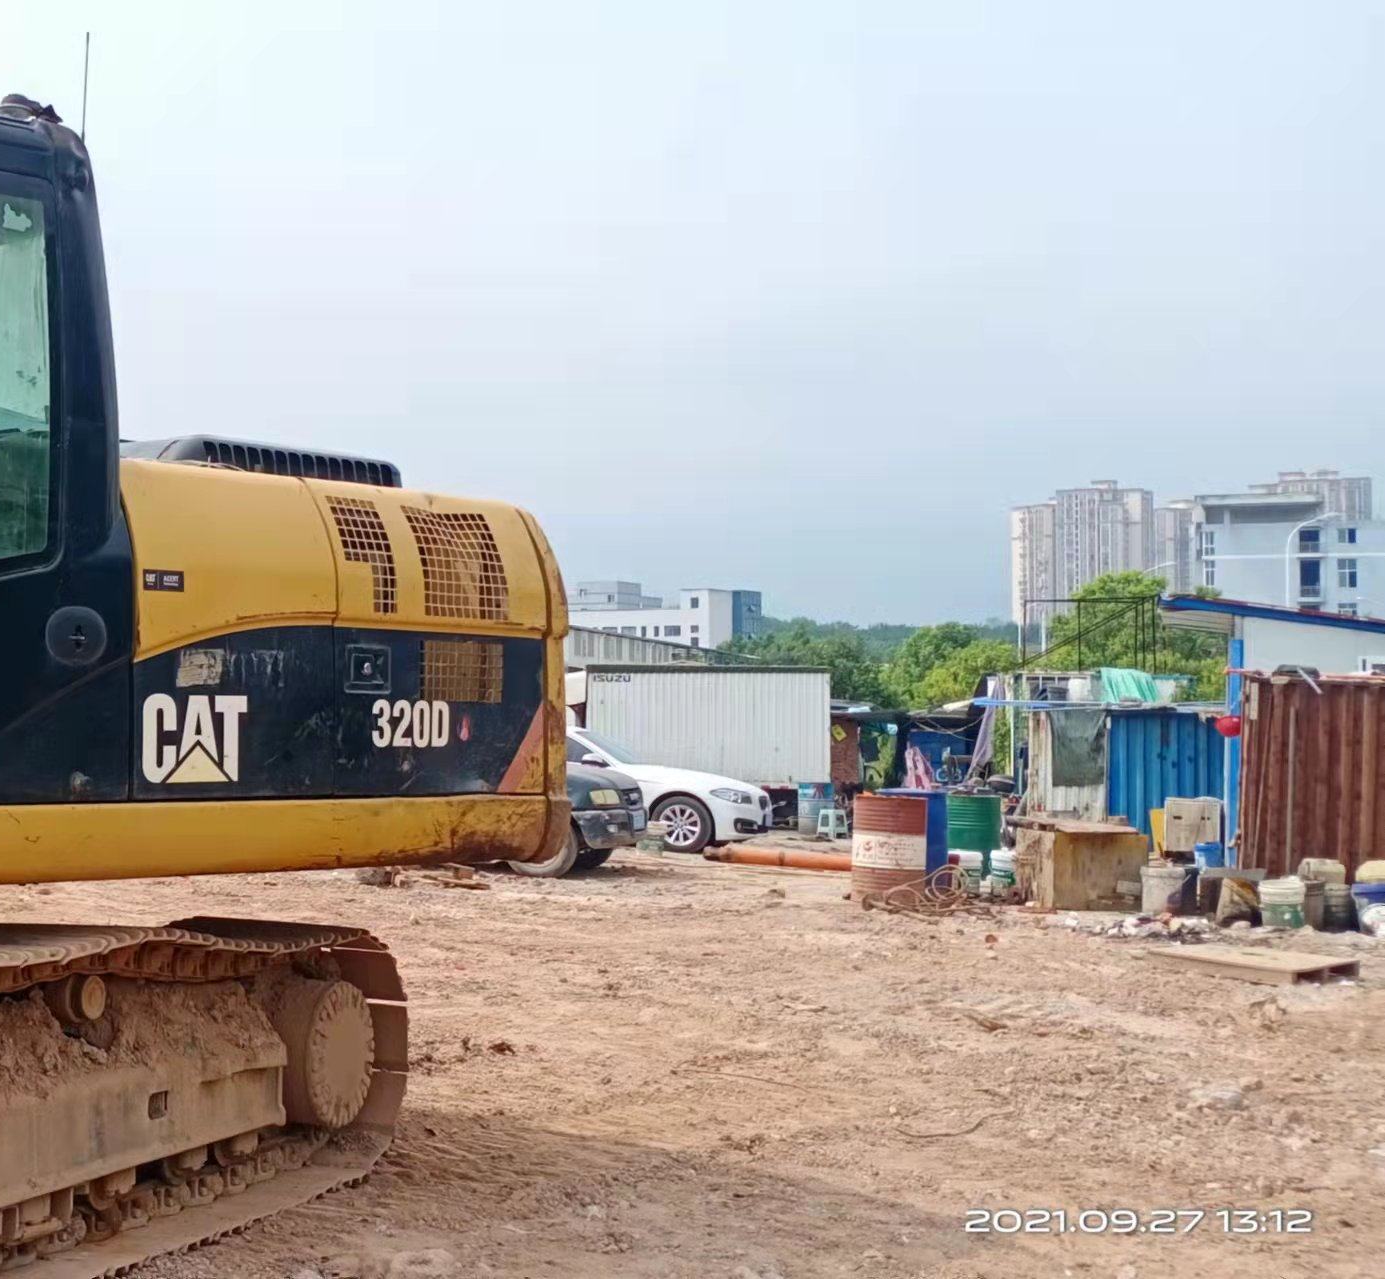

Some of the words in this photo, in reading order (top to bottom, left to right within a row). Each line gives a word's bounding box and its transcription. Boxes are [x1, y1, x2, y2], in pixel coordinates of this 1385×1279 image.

[593, 674, 631, 682] ISUZU
[142, 693, 248, 784] CAT
[371, 699, 449, 748] 320D
